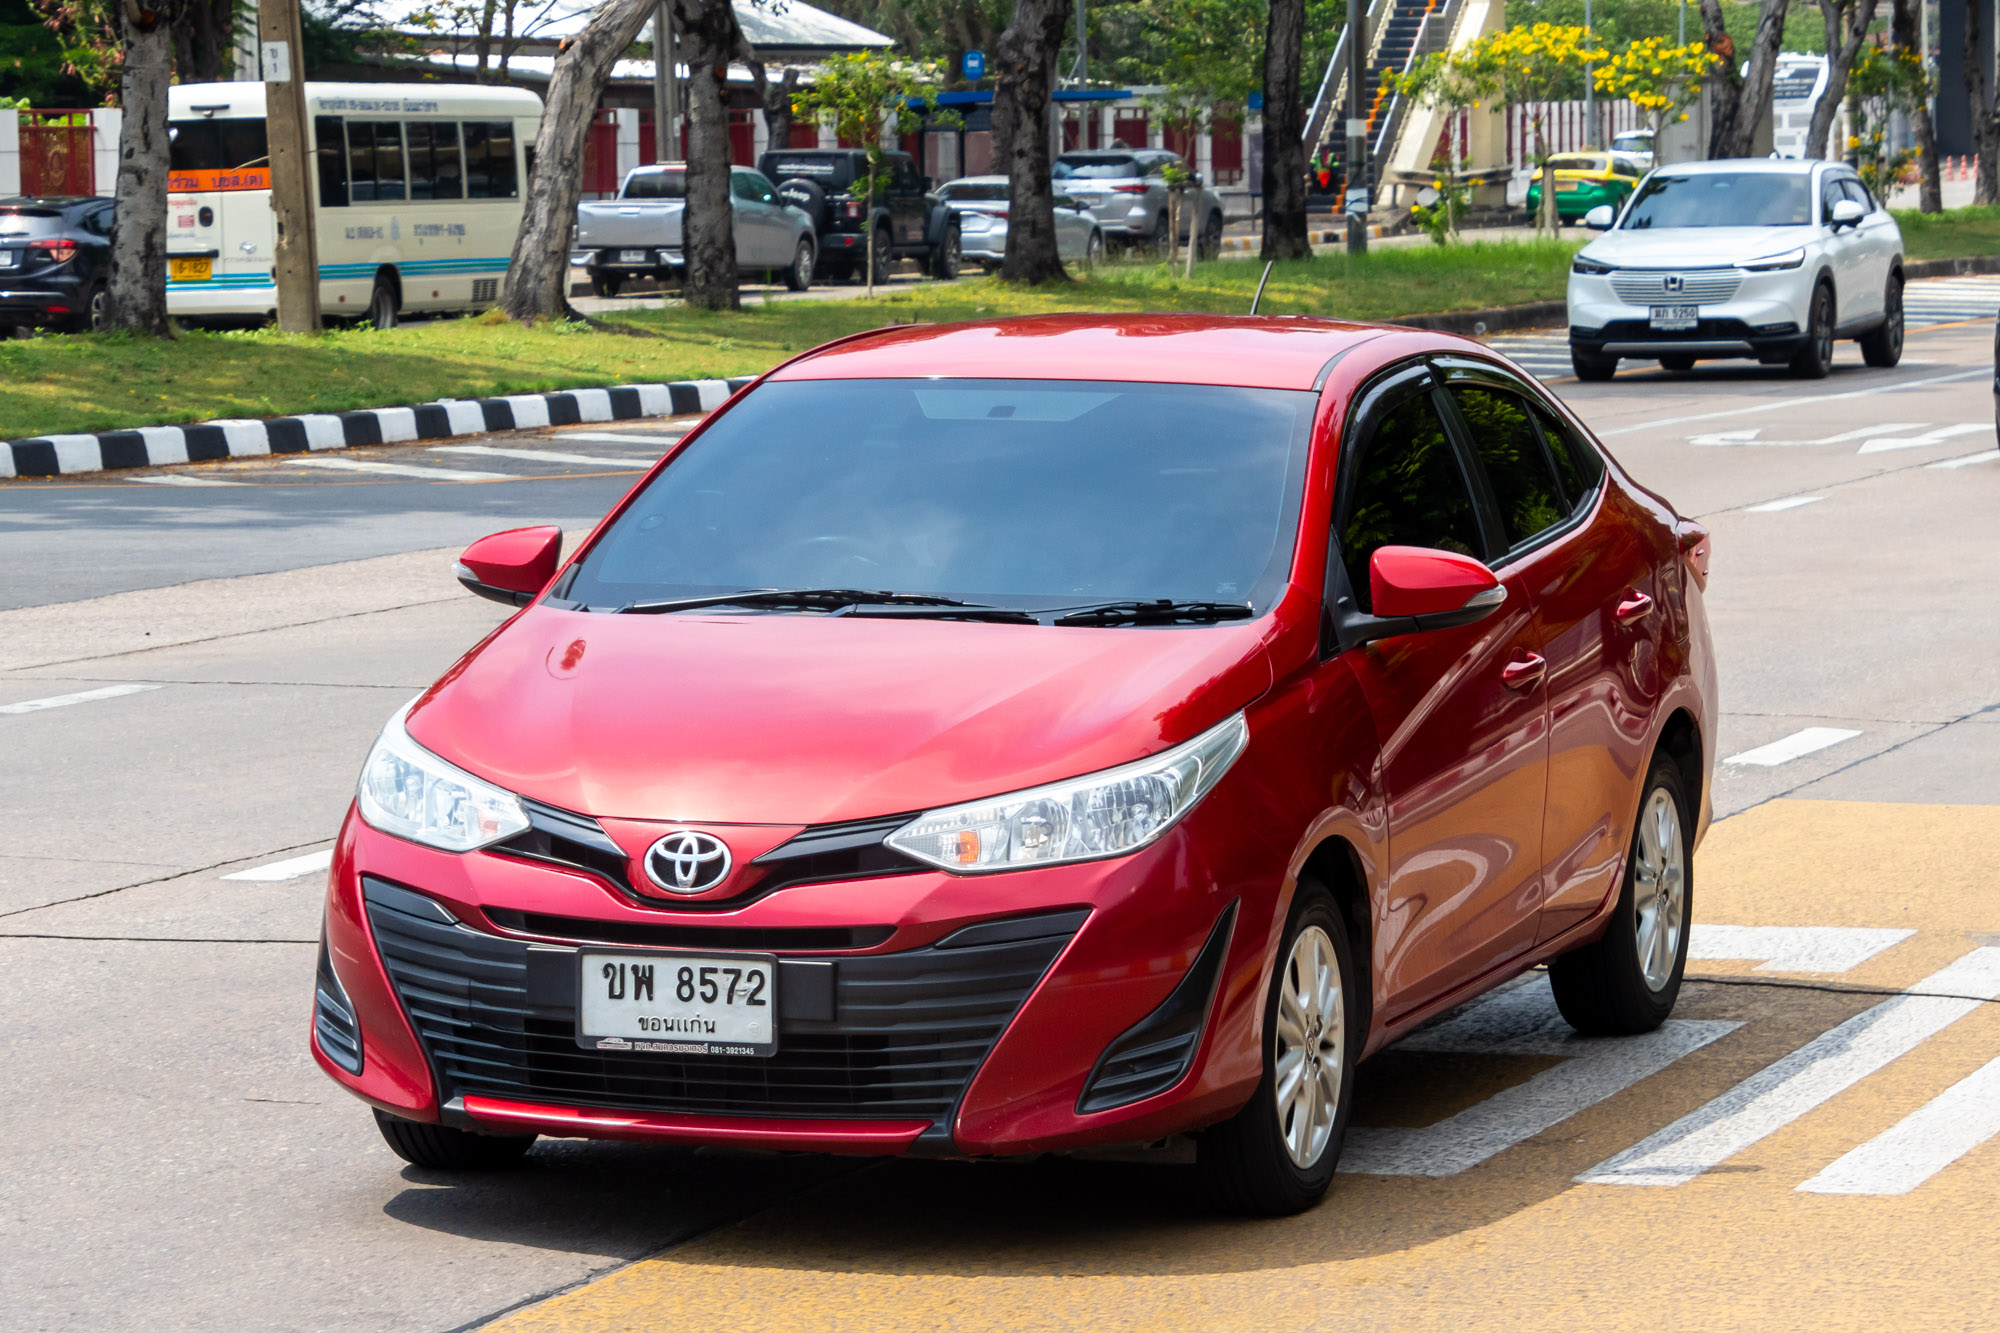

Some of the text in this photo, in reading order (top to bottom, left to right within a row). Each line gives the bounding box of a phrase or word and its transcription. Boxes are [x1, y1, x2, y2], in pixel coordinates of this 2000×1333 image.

[603, 962, 767, 1006] ขพ 8572
[638, 1013, 716, 1034] ขอนแก่น
[710, 1045, 755, 1055] 081-3921345
